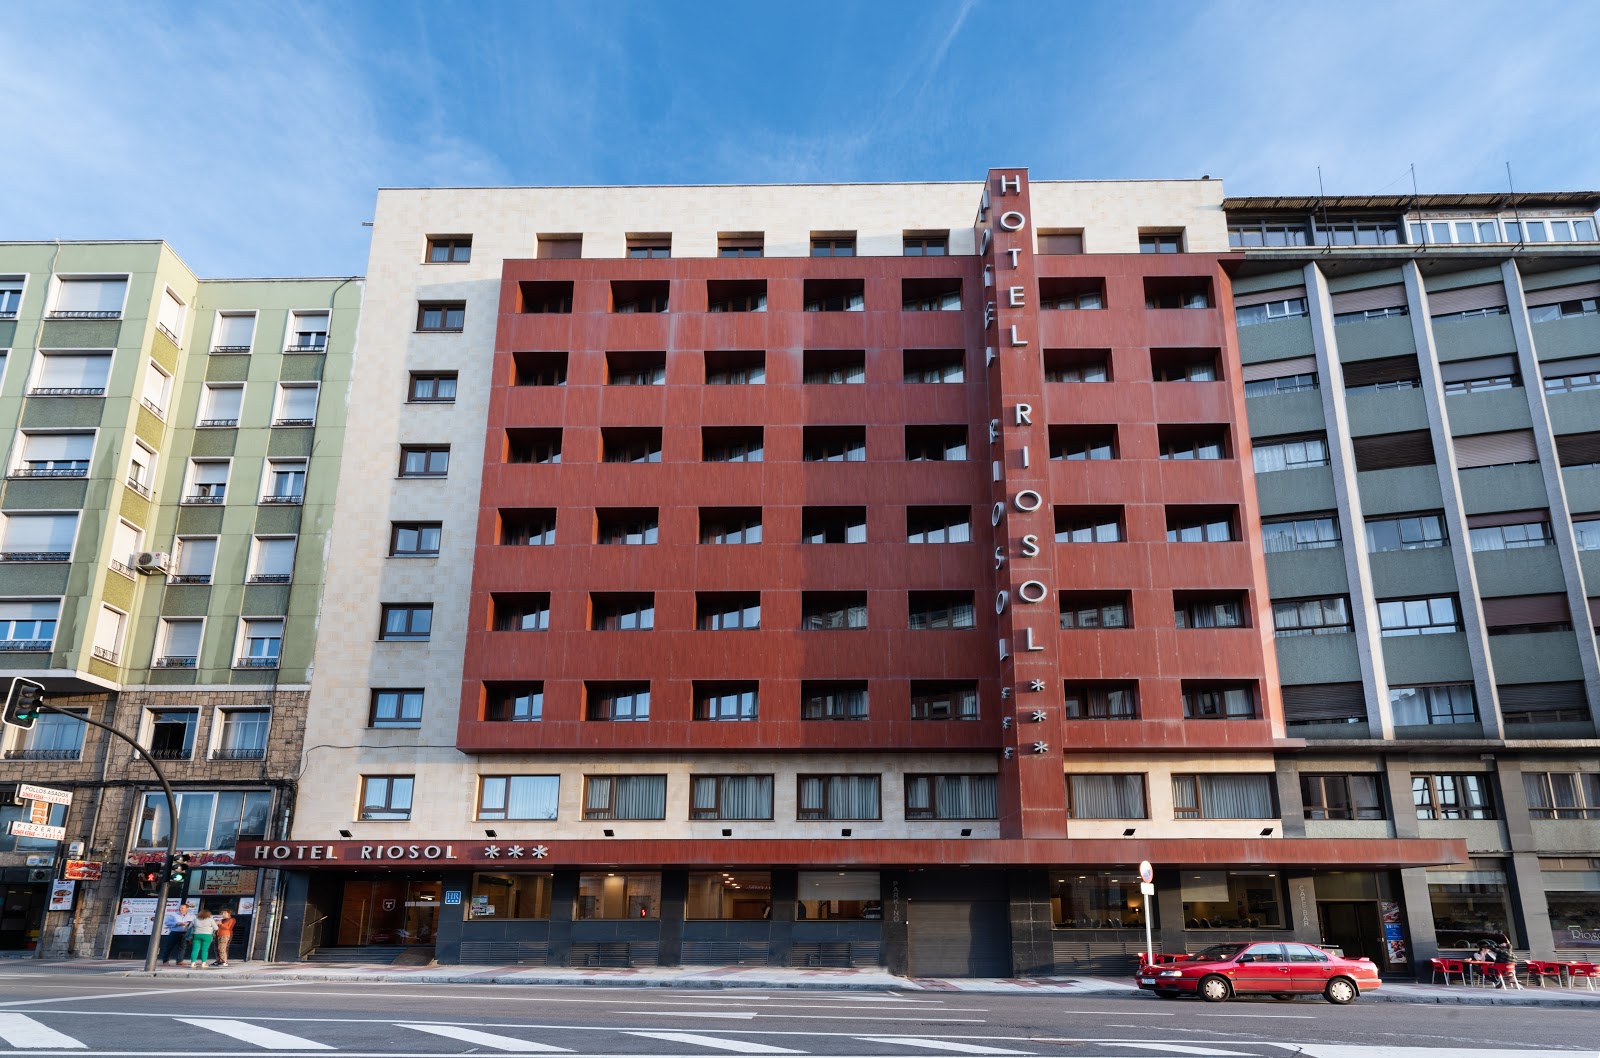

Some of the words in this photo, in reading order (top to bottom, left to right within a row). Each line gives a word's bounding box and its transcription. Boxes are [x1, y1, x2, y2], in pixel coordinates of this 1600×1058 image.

[1000, 175, 1028, 347] HOTEL
[1015, 403, 1048, 651] RIOSOL
[25, 786, 47, 795] POLLOS
[47, 790, 69, 798] ASADOS
[32, 801, 47, 824] BAR
[17, 823, 62, 835] PIZZERIA
[254, 845, 338, 859] HOTEL
[360, 845, 457, 859] RIOSOL
[447, 892, 459, 900] HR
